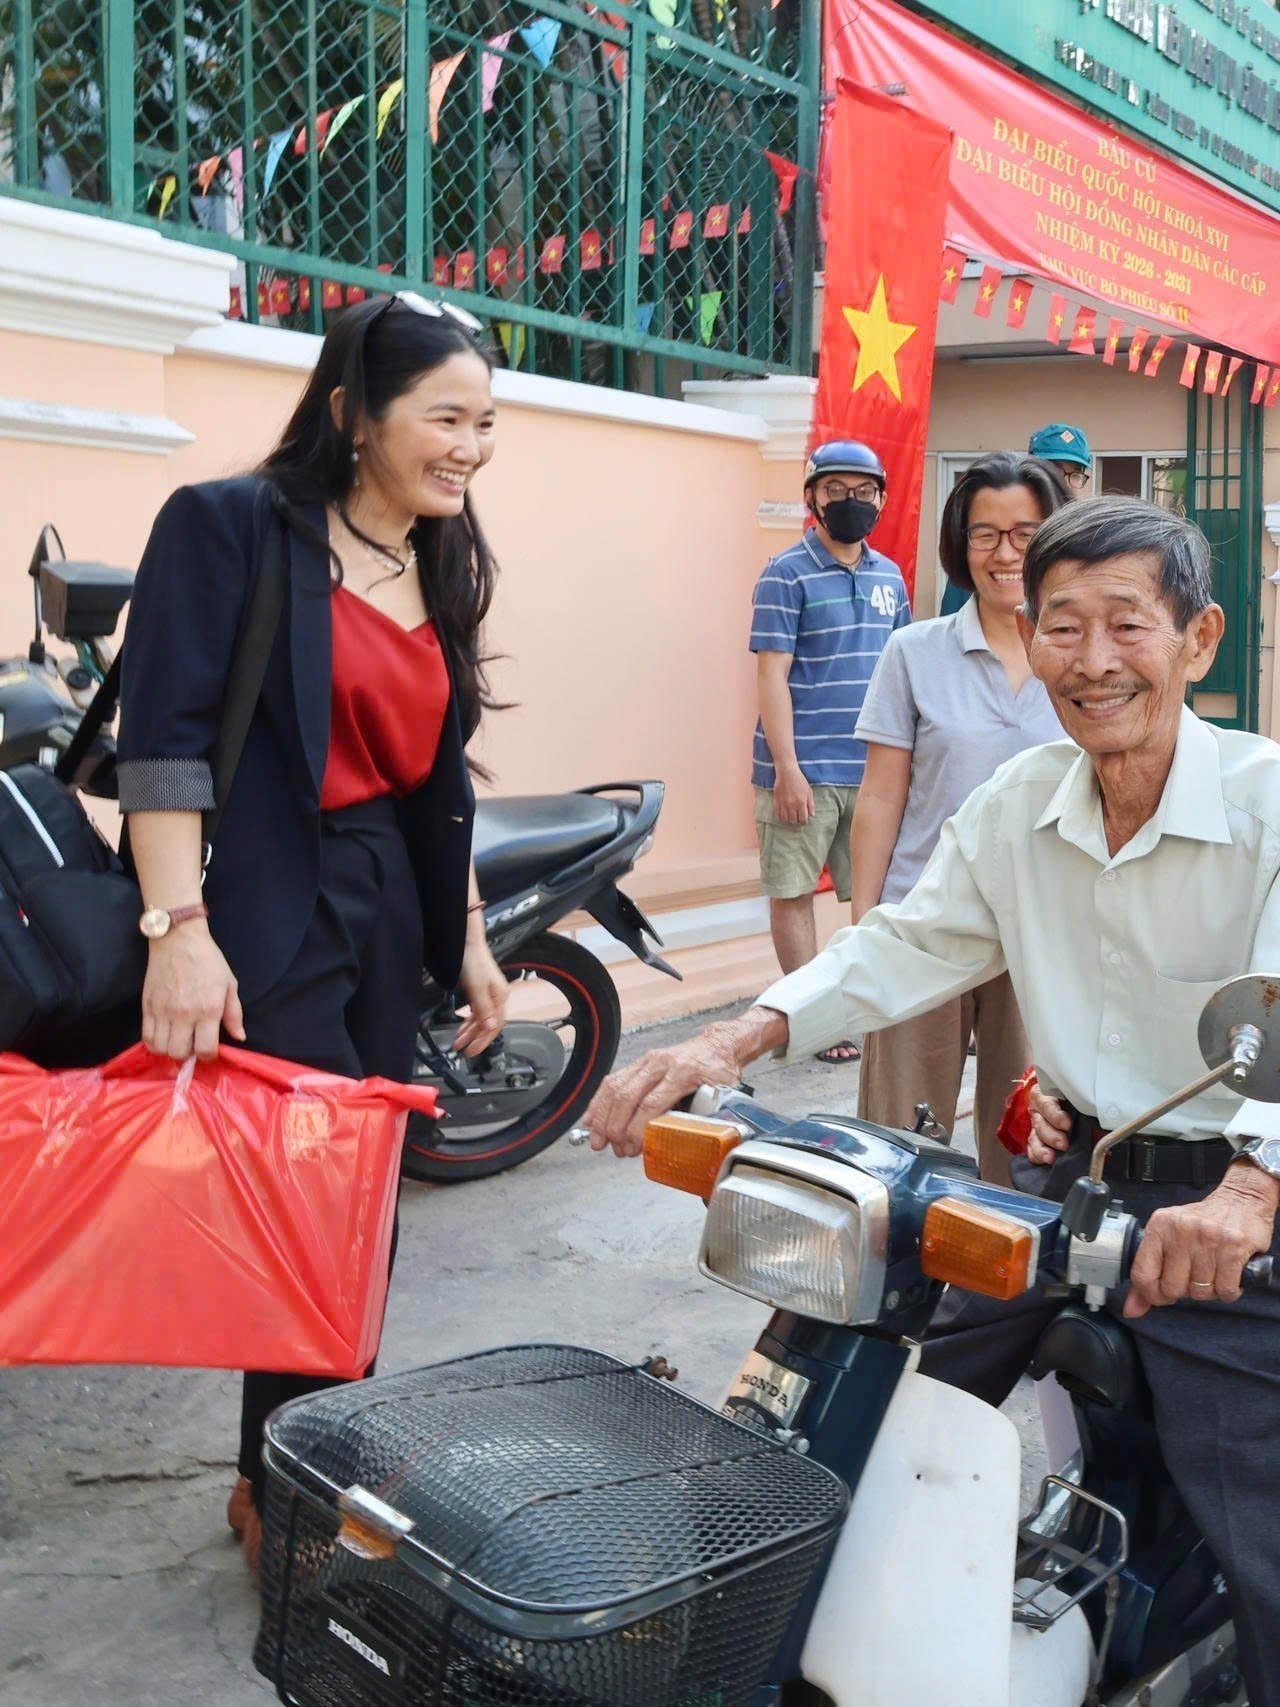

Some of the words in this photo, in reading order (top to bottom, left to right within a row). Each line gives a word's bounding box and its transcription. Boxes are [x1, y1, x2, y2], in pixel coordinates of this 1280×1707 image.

[956, 137, 993, 174] ĐẠI
[998, 157, 1045, 197] BIỂU
[1048, 182, 1082, 216] HỘI
[1085, 198, 1133, 238] ĐỒNG
[1136, 223, 1179, 258] NHÂN
[1182, 244, 1210, 273] DÂN
[1213, 259, 1240, 286] CÁC
[1241, 271, 1267, 298] CẤP
[992, 117, 1031, 154] ĐẠI
[1033, 138, 1080, 177] BIỂU
[1082, 163, 1129, 201] QUỐC
[1132, 189, 1162, 219] HỘI
[1206, 225, 1229, 252] XVI
[1035, 211, 1095, 256] NHIỆM
[1122, 250, 1155, 280] 2026
[1164, 269, 1192, 296] 2031
[870, 584, 896, 617] 46
[740, 1373, 789, 1408] HONDA
[327, 1617, 391, 1677] HONDA
